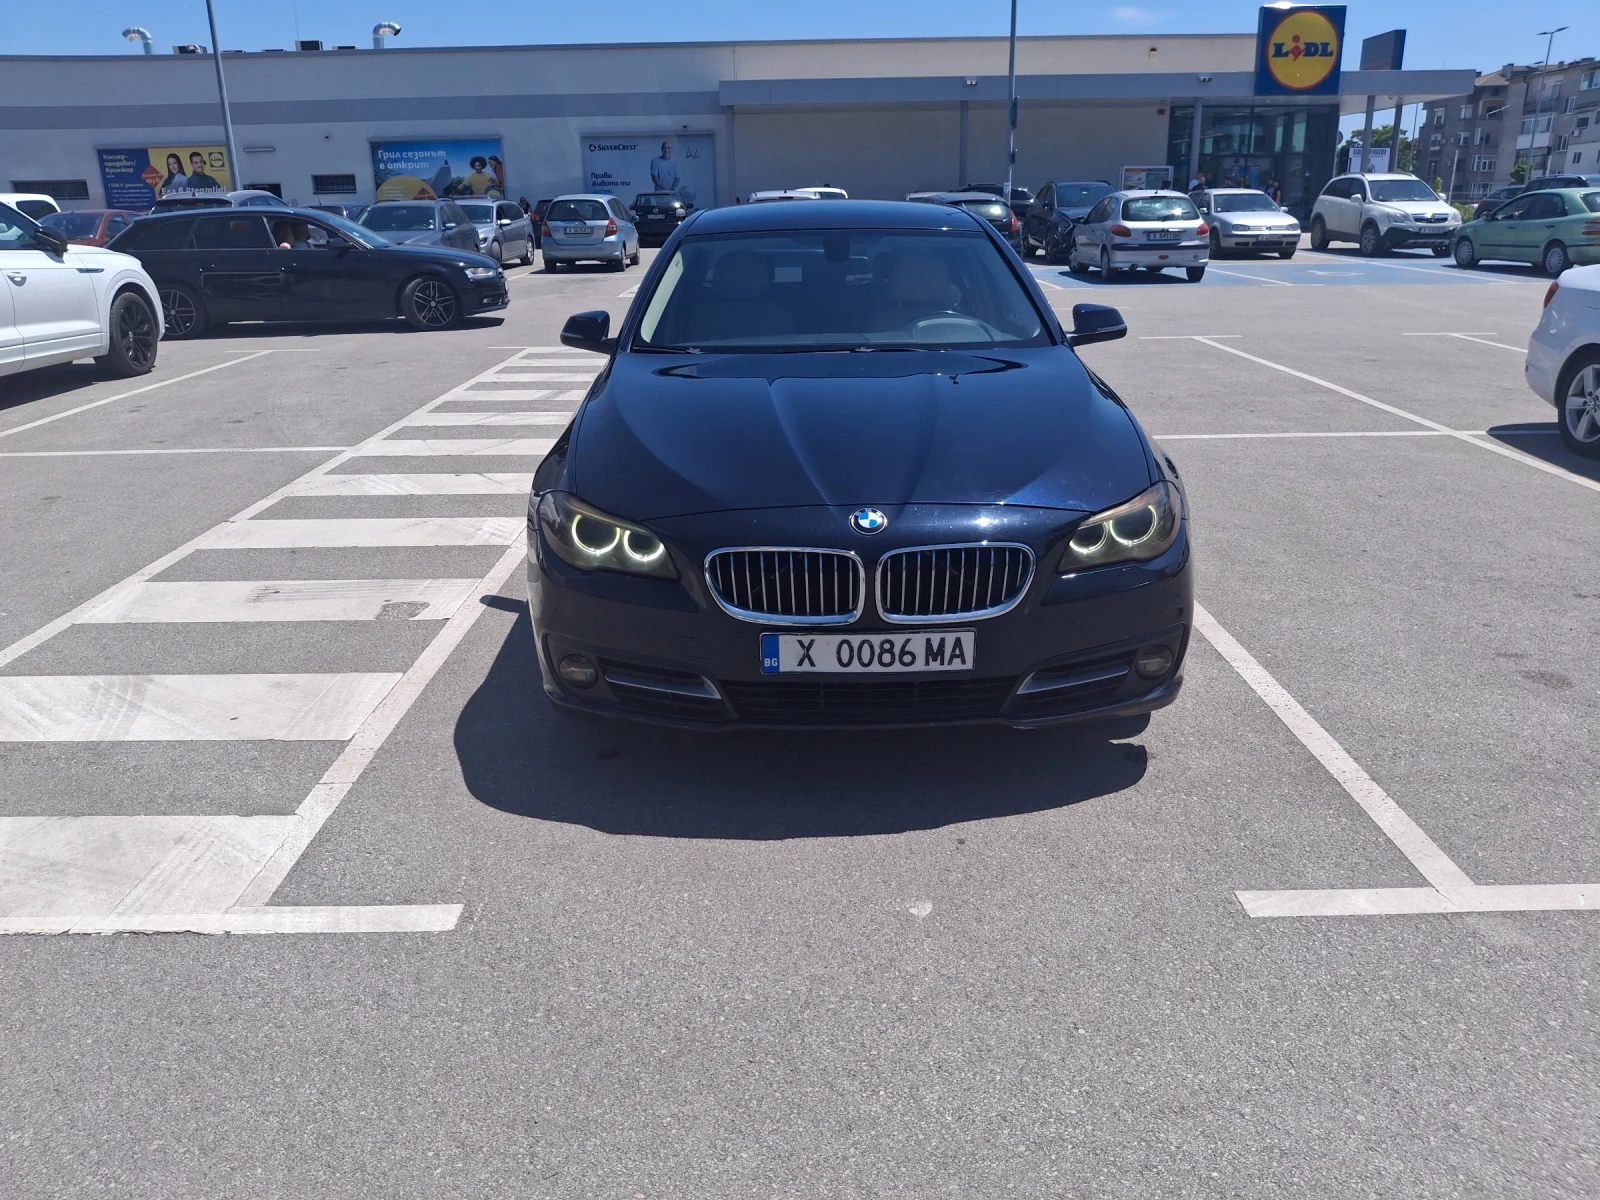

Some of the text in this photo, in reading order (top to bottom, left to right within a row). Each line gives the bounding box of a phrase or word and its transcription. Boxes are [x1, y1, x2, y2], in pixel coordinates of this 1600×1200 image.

[378, 150, 446, 160] Грил сезонът
[379, 161, 429, 170] е открит
[590, 172, 612, 180] Прави
[797, 636, 967, 668] X 0086 MA
[764, 658, 778, 667] BG
